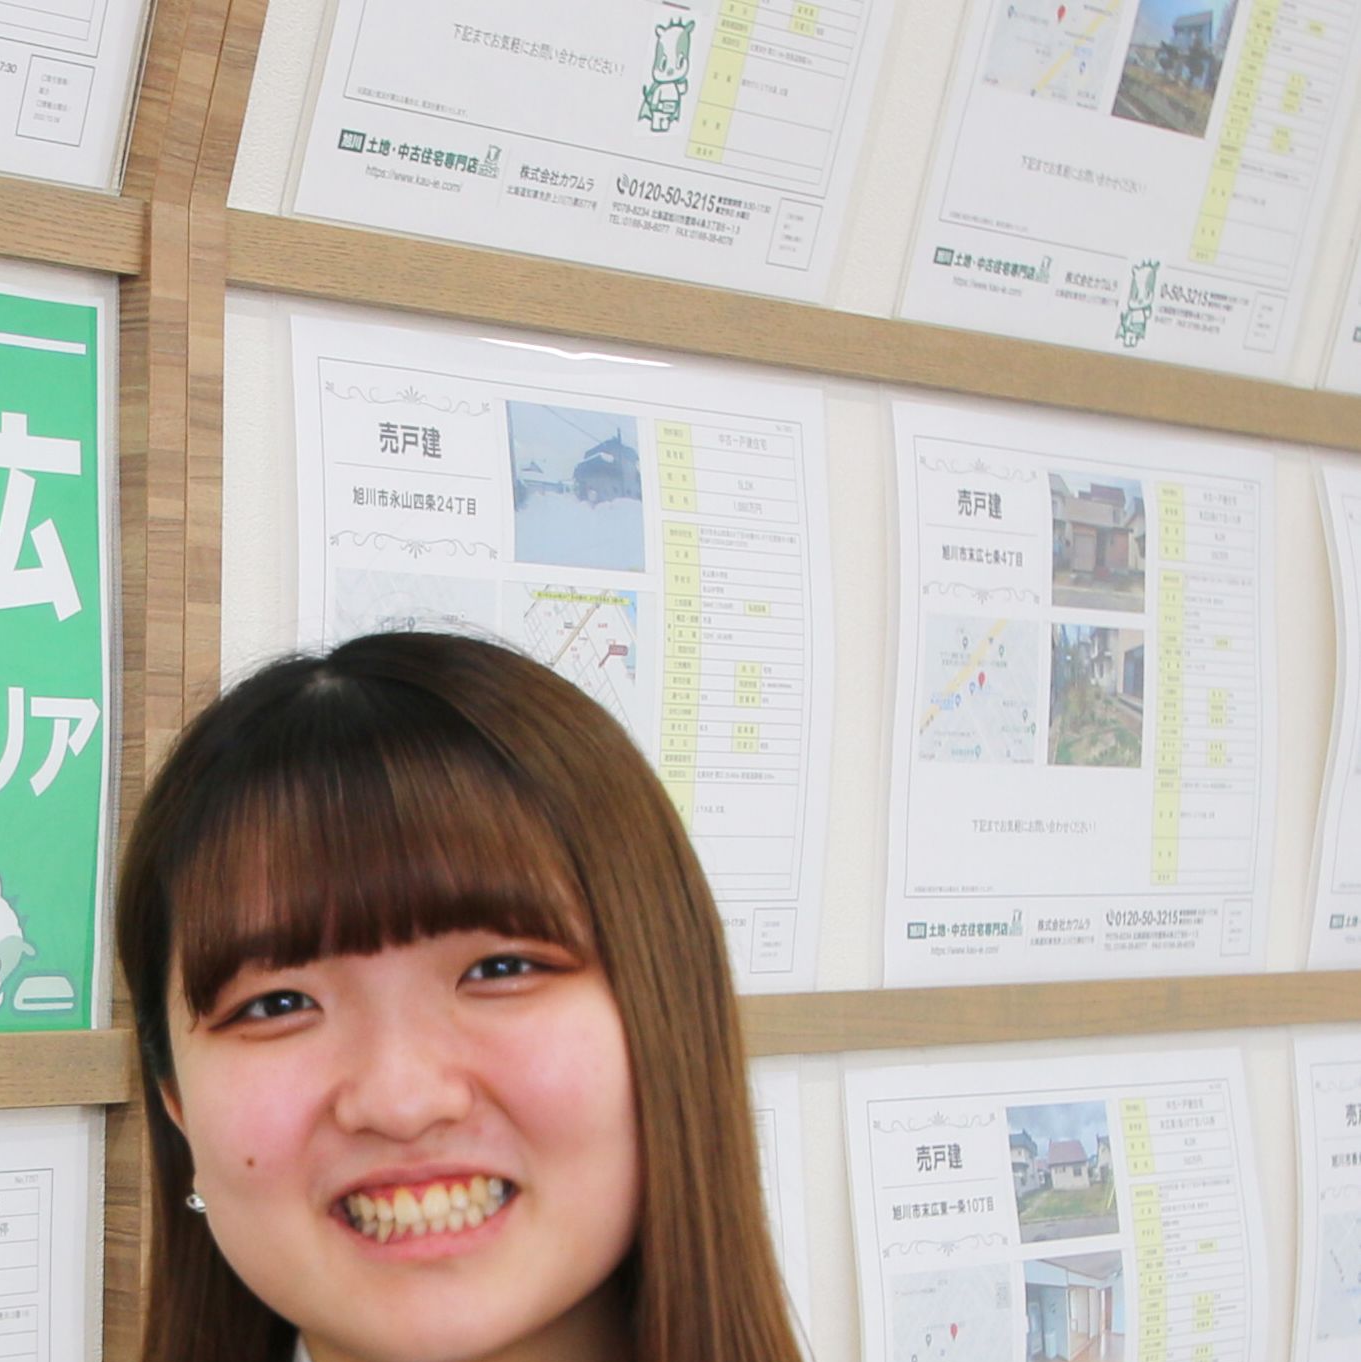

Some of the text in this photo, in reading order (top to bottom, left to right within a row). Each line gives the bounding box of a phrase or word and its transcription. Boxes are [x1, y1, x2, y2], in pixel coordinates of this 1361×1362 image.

[366, 137, 480, 175] 土地・中古住宅専門店
[520, 165, 596, 192] 株式会社カワムラ
[628, 178, 716, 213] 0120-50-3215
[378, 421, 442, 460] 売戸建
[352, 486, 478, 517] 旭川市永山四条24丁目
[957, 488, 1003, 521] 売戸建
[1114, 909, 1179, 926] 0120-50-3215
[915, 1142, 964, 1173] 売戸建
